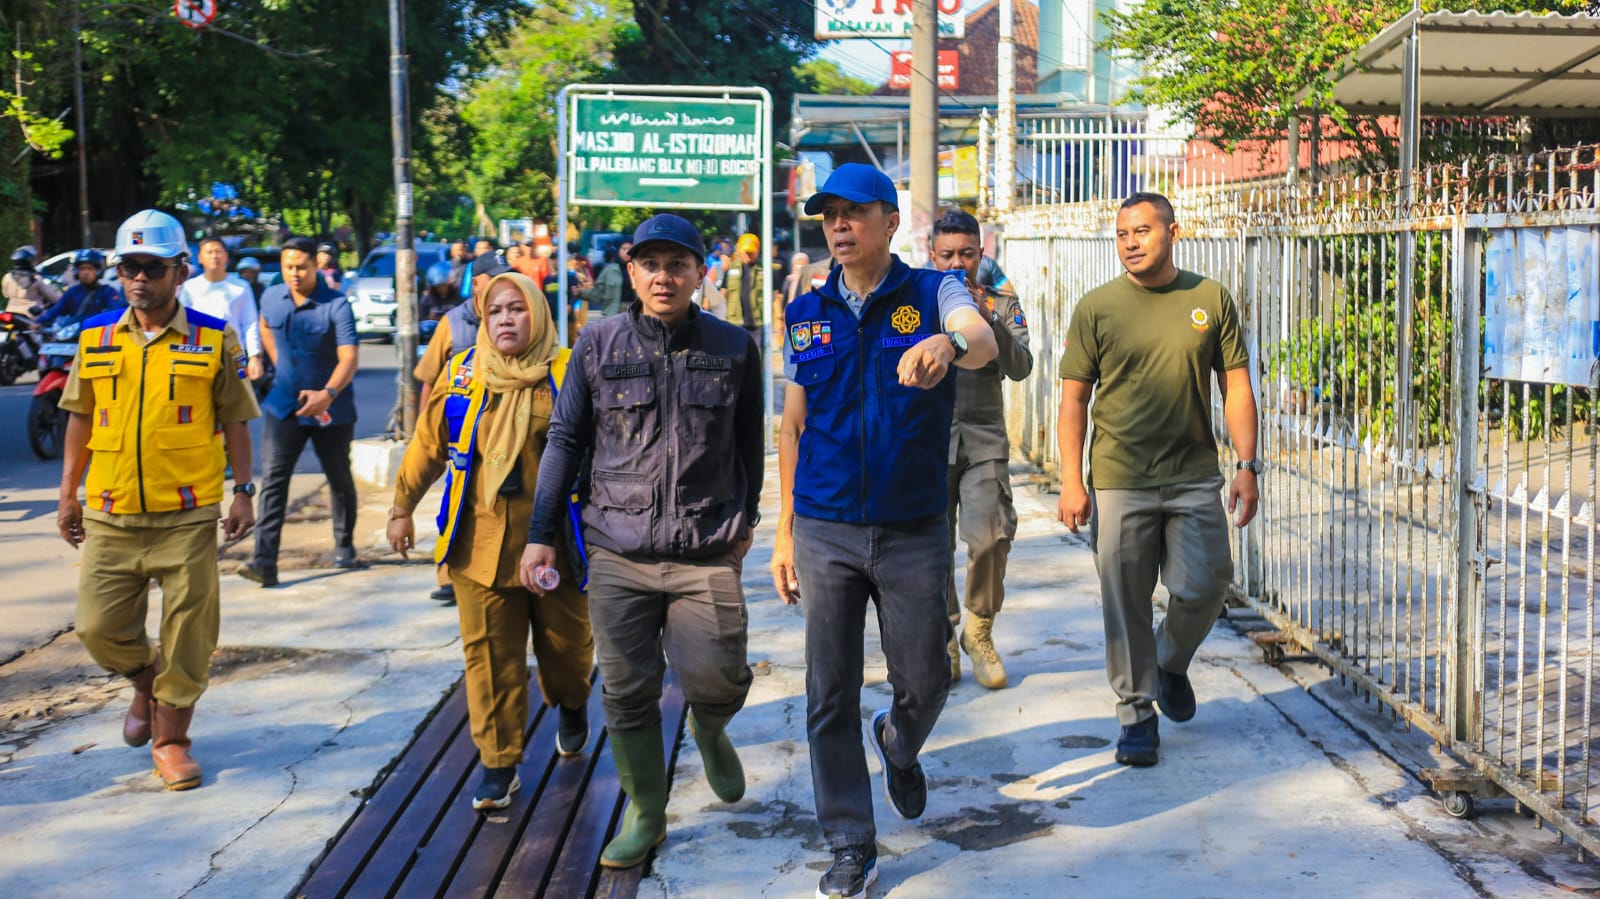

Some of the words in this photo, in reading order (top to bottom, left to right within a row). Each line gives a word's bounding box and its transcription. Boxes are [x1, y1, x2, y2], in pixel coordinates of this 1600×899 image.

[828, 19, 892, 32] MASAKAN
[576, 131, 635, 153] MASJID
[641, 132, 756, 155] AL-ISTIQOMAH
[657, 157, 685, 174] BLK
[885, 337, 906, 347] WALI
